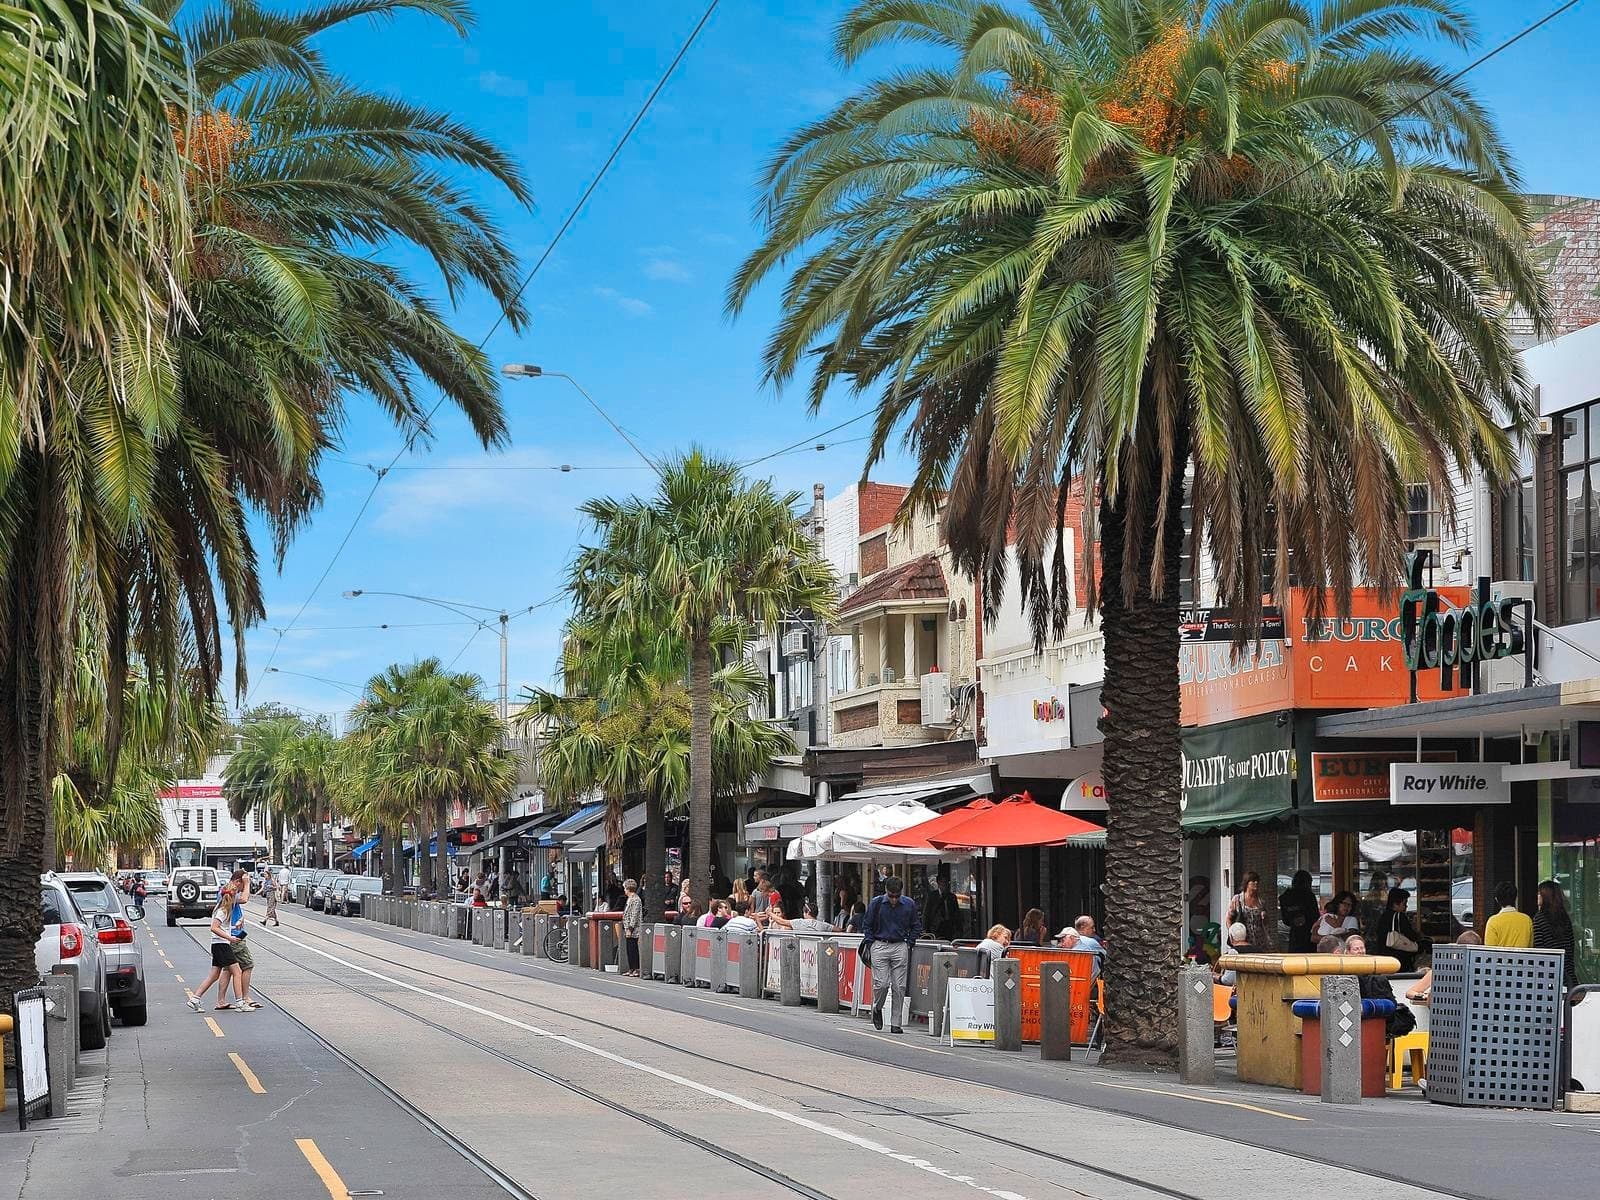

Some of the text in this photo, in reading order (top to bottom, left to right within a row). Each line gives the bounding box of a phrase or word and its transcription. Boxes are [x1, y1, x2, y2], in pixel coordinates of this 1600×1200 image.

[1212, 622, 1222, 630] The
[1302, 617, 1402, 642] EURO
[1309, 655, 1393, 673] CAK
[1248, 669, 1277, 685] CAKES
[1228, 758, 1235, 778] is
[1236, 760, 1250, 777] our
[1251, 749, 1290, 779] POLICY
[1318, 757, 1384, 777] EUR
[1319, 786, 1375, 796] INTERNATIONAL
[1403, 775, 1437, 793] Ray
[954, 983, 993, 994] Office Op
[968, 1022, 982, 1031] Ray
